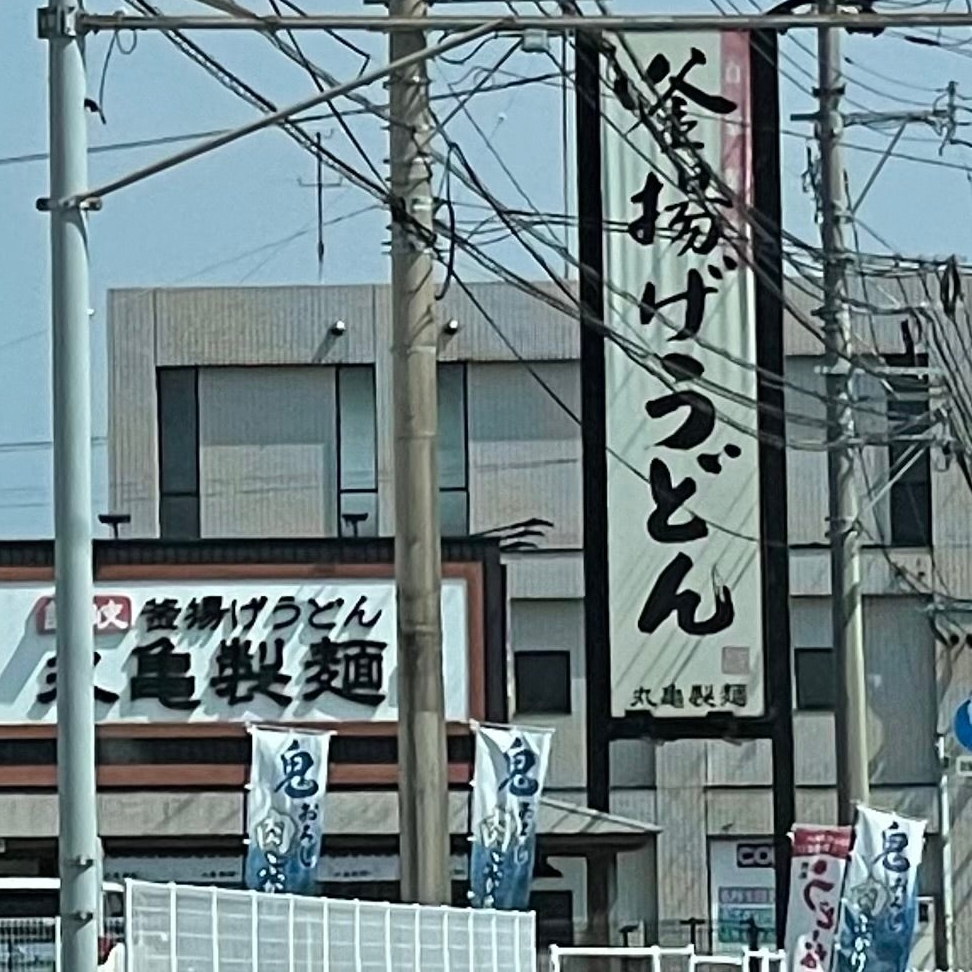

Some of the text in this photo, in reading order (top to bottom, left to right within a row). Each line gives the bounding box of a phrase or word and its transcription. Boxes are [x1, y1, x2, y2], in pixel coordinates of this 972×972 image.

[629, 47, 742, 637] 釜揚げうどん
[44, 598, 129, 630] 岐
[140, 595, 383, 631] 釜揚げうどん
[630, 683, 748, 708] 丸亀製麺
